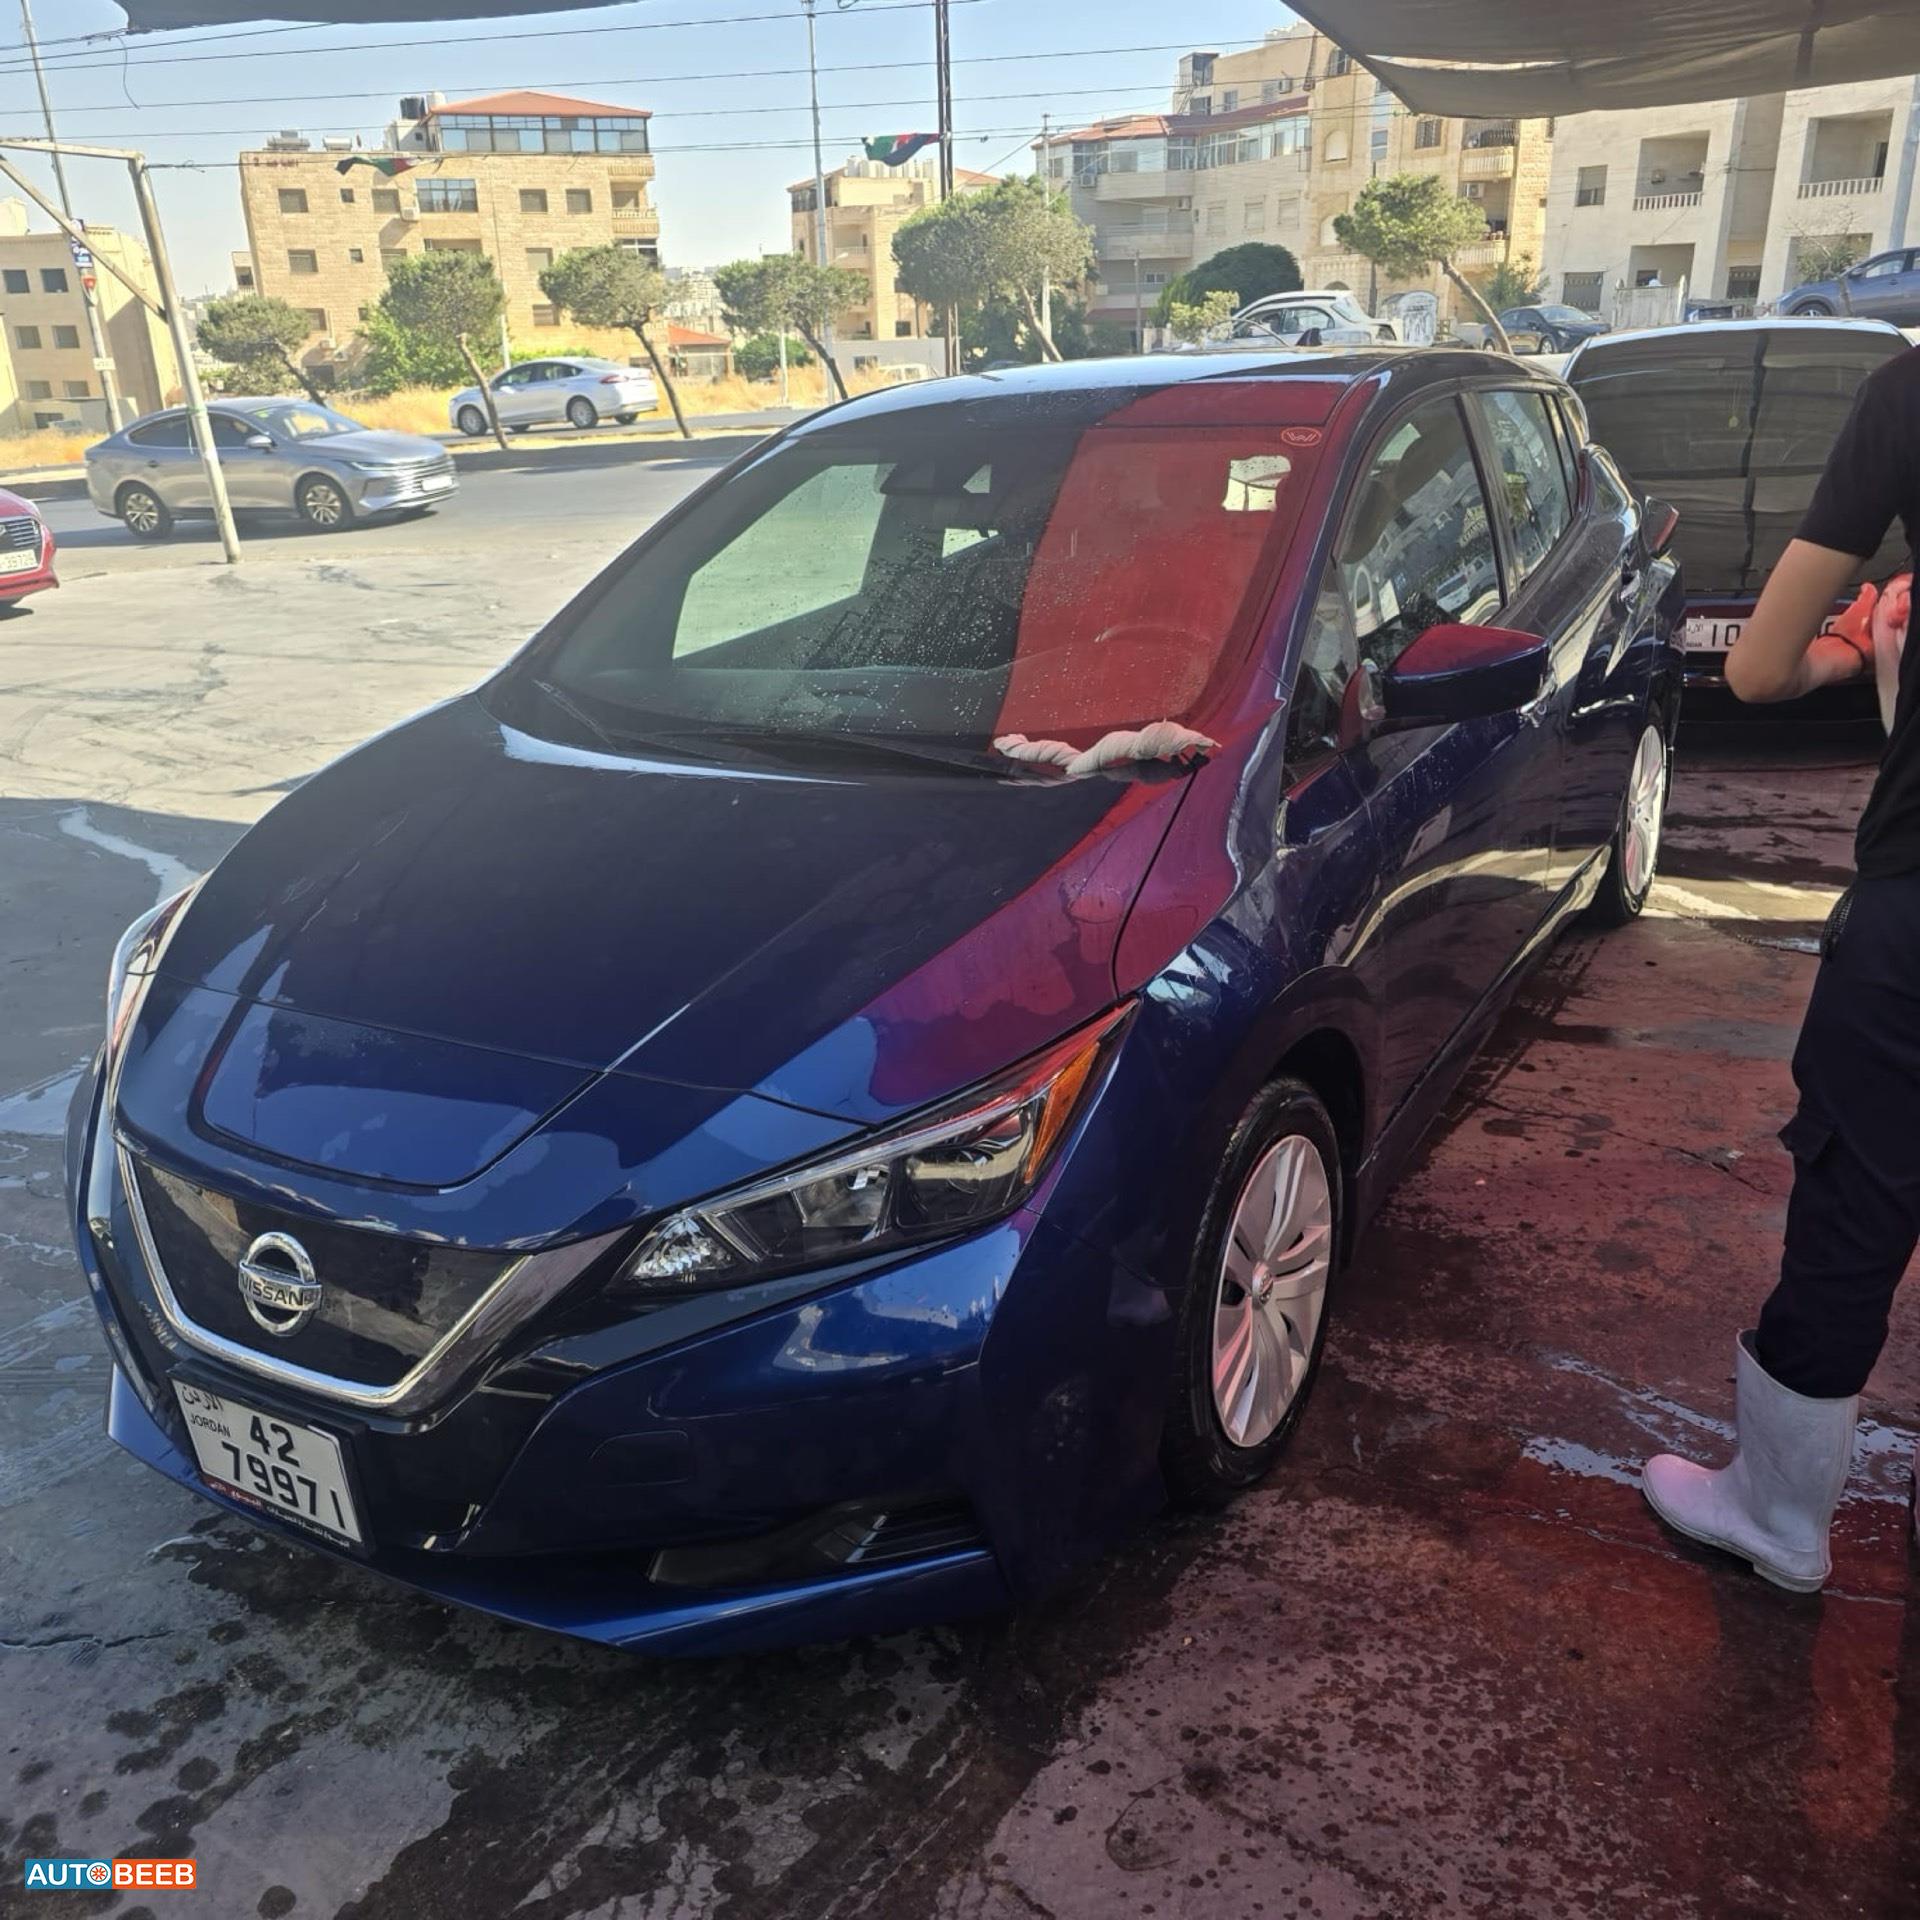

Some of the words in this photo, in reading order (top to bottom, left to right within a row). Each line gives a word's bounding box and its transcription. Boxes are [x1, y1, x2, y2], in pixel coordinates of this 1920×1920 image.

[239, 1270, 304, 1306] NISSAN
[191, 1413, 231, 1437] JORDAN
[250, 1415, 300, 1468] 42
[221, 1440, 346, 1530] 79971
